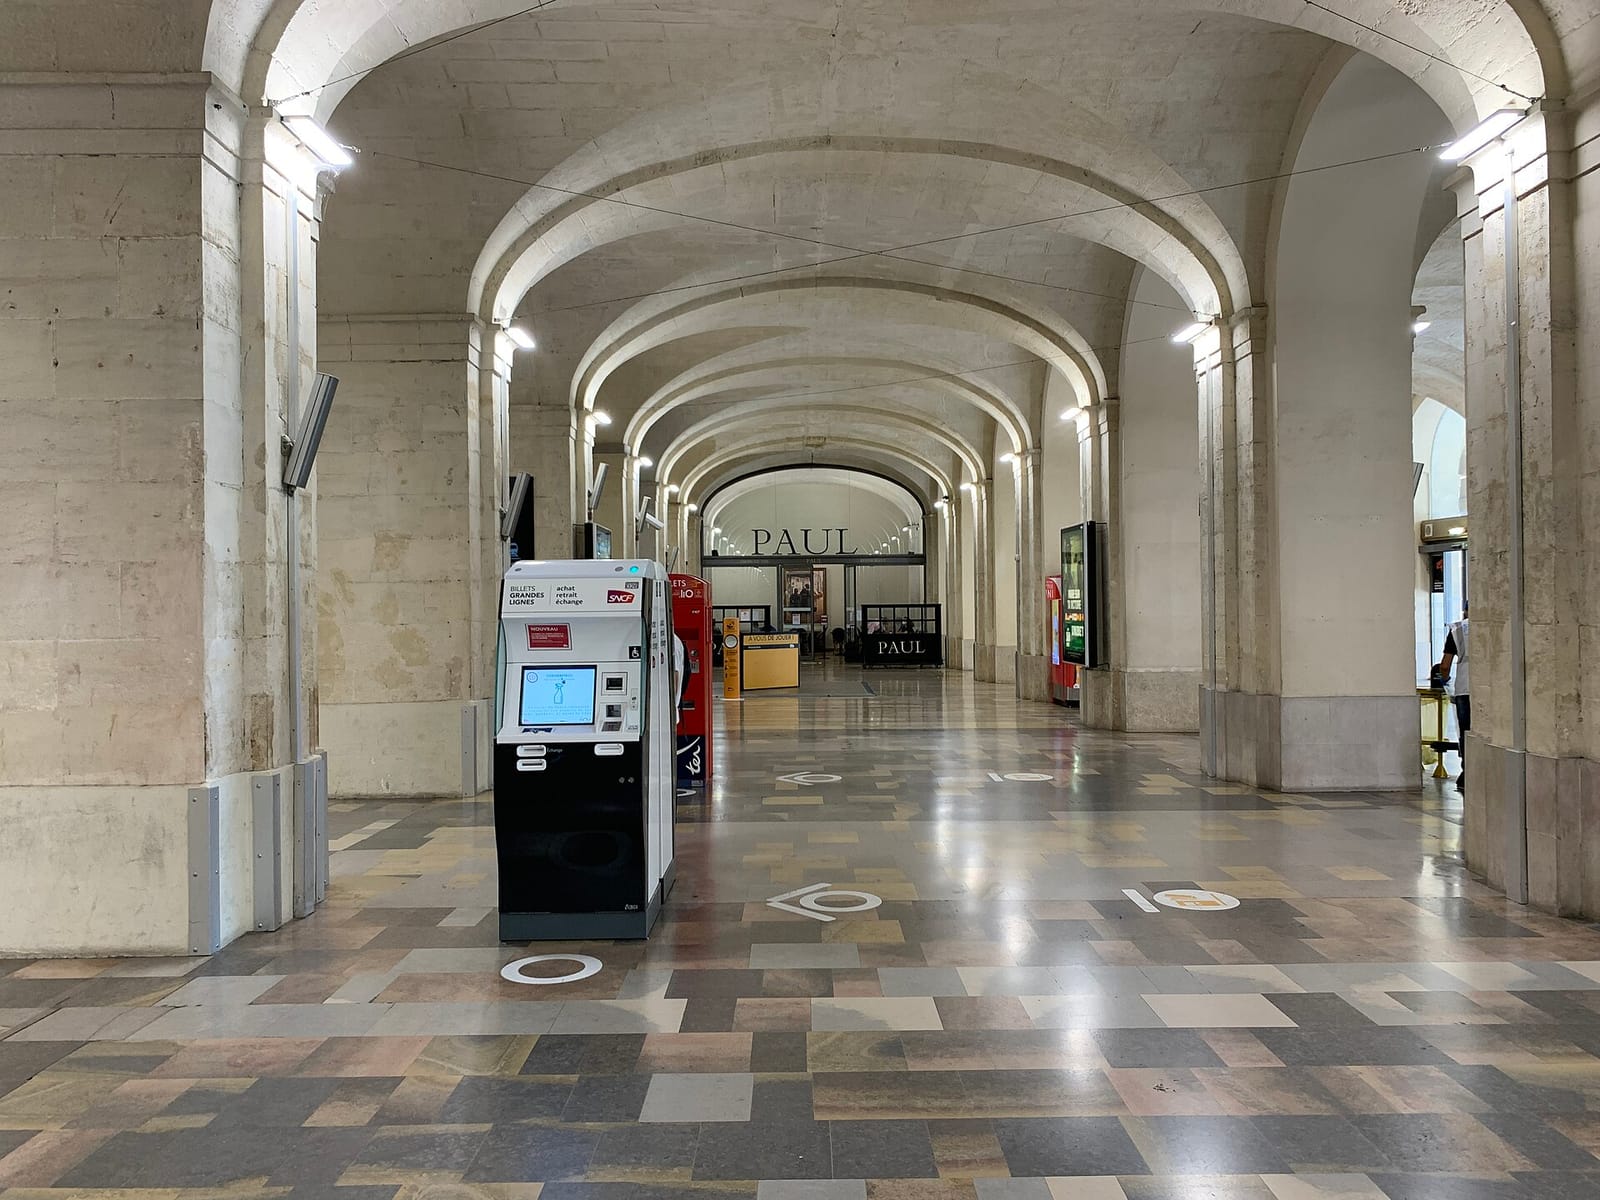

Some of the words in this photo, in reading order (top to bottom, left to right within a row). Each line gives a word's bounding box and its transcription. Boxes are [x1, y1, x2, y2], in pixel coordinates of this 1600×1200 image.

[751, 528, 858, 556] PAUL
[671, 579, 687, 588] ETS
[555, 598, 584, 606] échange
[608, 594, 634, 603] SNCF
[878, 640, 926, 654] PAUL
